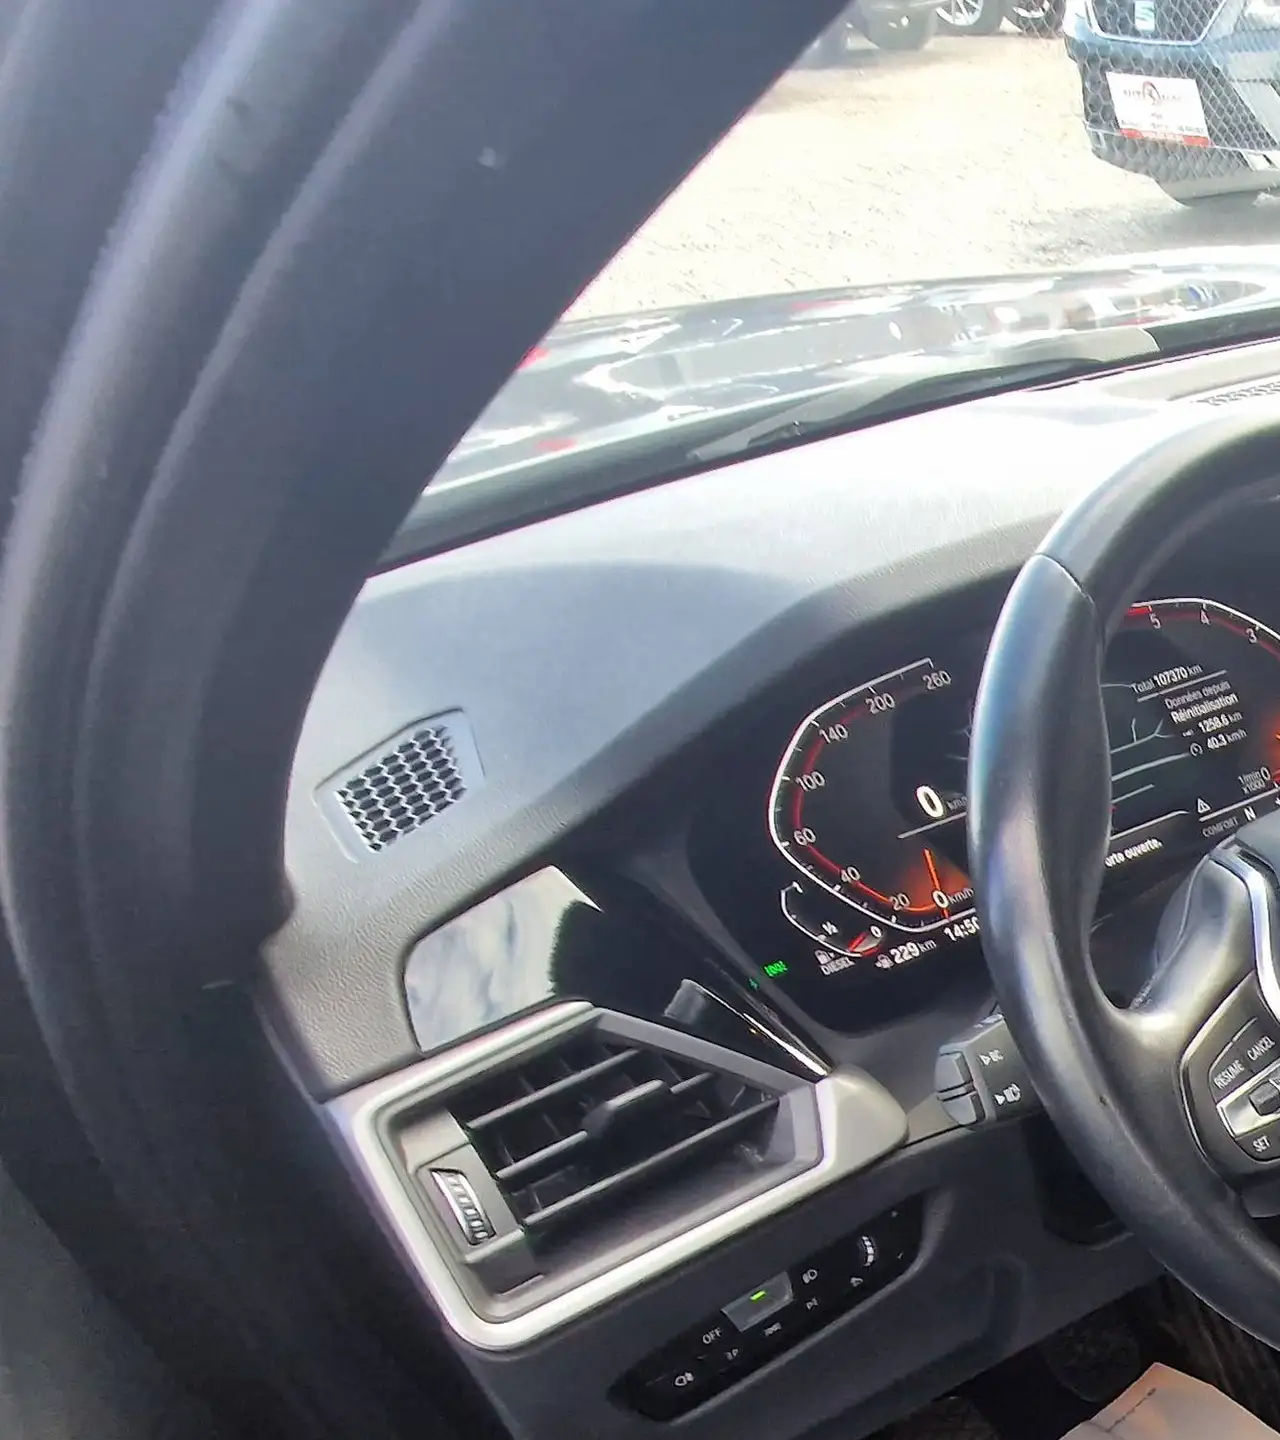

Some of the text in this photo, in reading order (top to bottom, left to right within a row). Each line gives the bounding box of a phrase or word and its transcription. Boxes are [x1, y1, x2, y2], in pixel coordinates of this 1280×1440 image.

[1150, 613, 1161, 629] 5
[1200, 609, 1211, 625] 4
[1246, 628, 1258, 644] 3
[922, 669, 951, 691] 260
[1131, 663, 1204, 694] Total 107370 km
[865, 693, 896, 715] 200
[1164, 680, 1232, 710] Données depuis
[1169, 693, 1239, 725] Réinitialisation
[819, 723, 849, 744] 140
[1207, 734, 1228, 751] 40.3
[795, 770, 826, 792] 100
[1260, 766, 1272, 781] 0
[916, 785, 945, 819] 0
[1243, 805, 1257, 822] N
[793, 827, 818, 846] 60
[839, 867, 862, 885] 40
[890, 892, 912, 912] 20
[932, 889, 950, 910] 0
[869, 925, 884, 938] 0
[889, 942, 921, 965] 229
[918, 937, 938, 955] km
[819, 956, 856, 976] DIESEL
[1247, 1035, 1276, 1062] CANCEL
[1213, 1059, 1246, 1091] RESUME
[1252, 1135, 1272, 1153] SET
[701, 1326, 723, 1345] OFF
